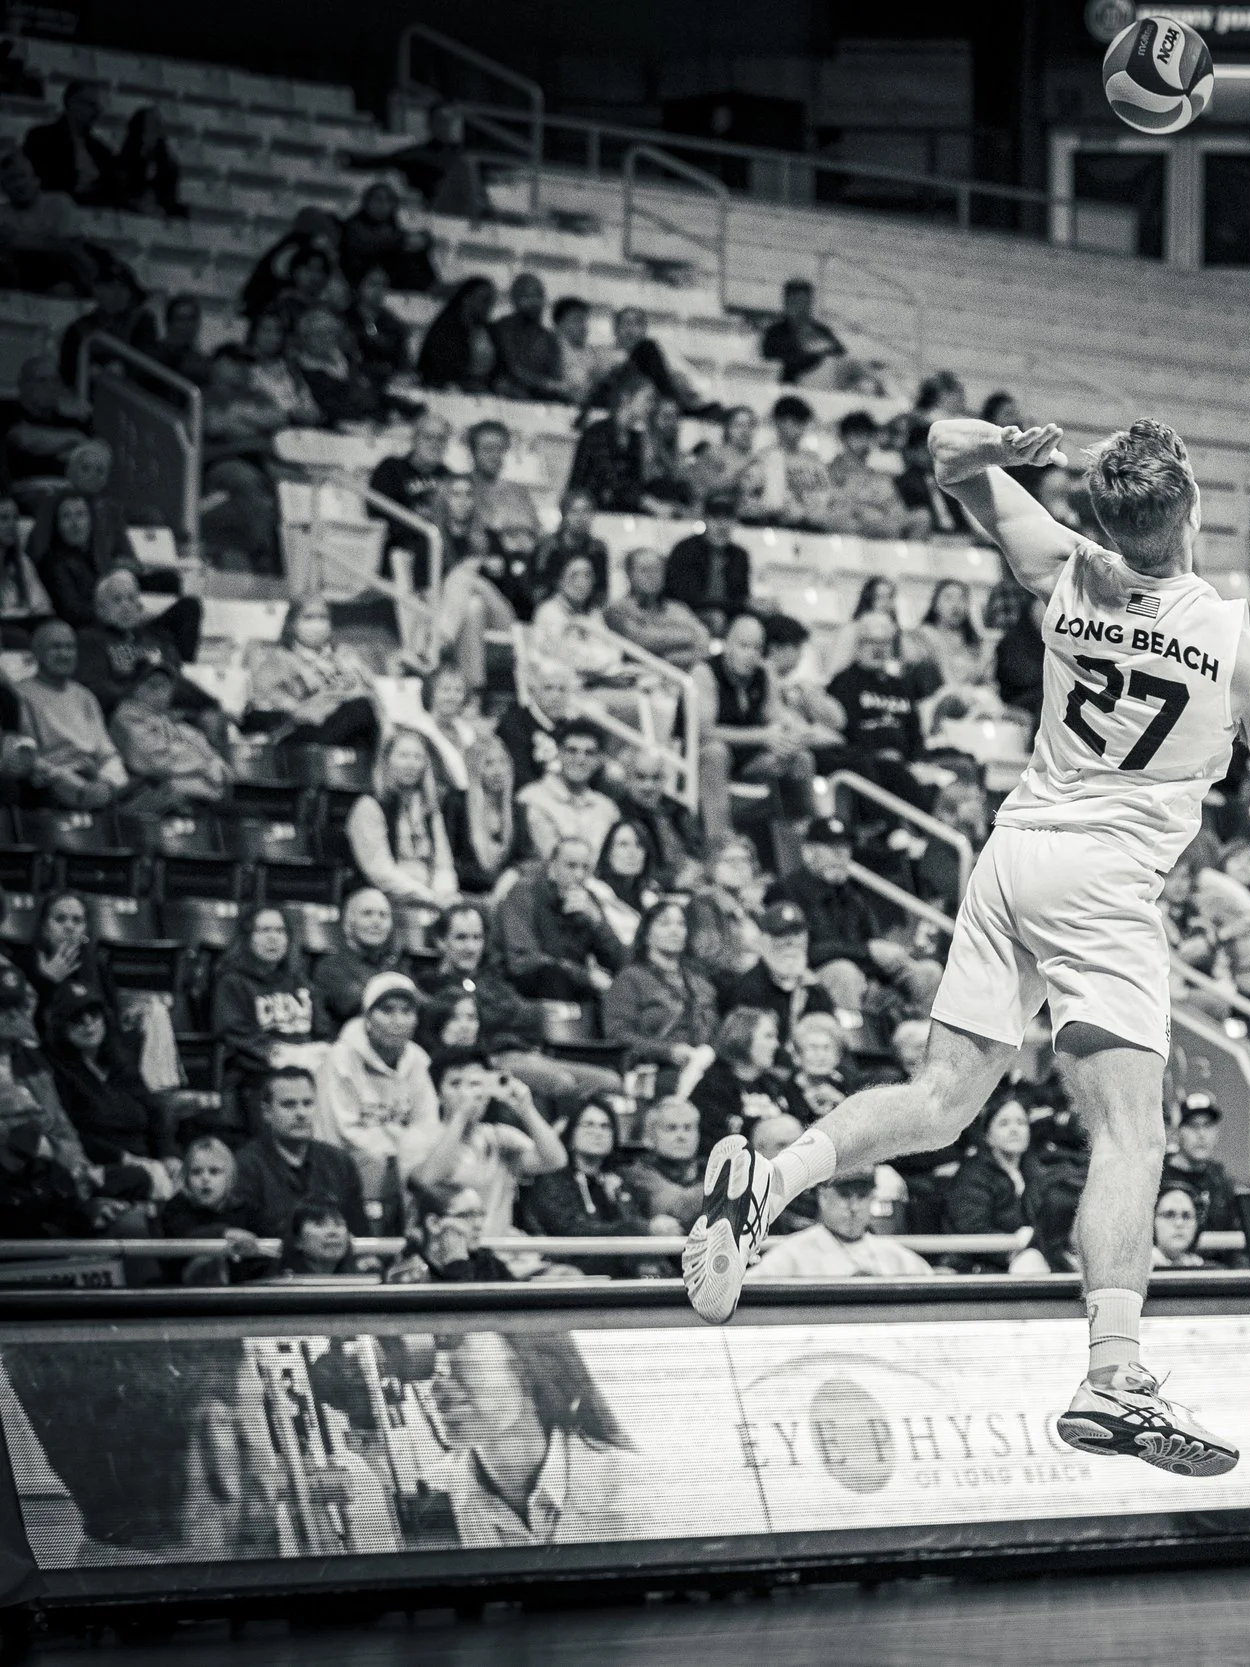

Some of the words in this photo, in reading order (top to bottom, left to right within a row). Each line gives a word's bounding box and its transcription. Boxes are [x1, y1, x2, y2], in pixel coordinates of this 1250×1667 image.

[1157, 26, 1180, 65] NCAA
[1054, 613, 1124, 644] LONG
[1131, 628, 1219, 682] BEACH
[1063, 654, 1190, 770] 27
[734, 1419, 848, 1469] EYE
[867, 1411, 1079, 1465] PHYSIC
[914, 1468, 943, 1491] OF
[951, 1465, 1014, 1489] LONG
[1022, 1461, 1093, 1487] BEACH
